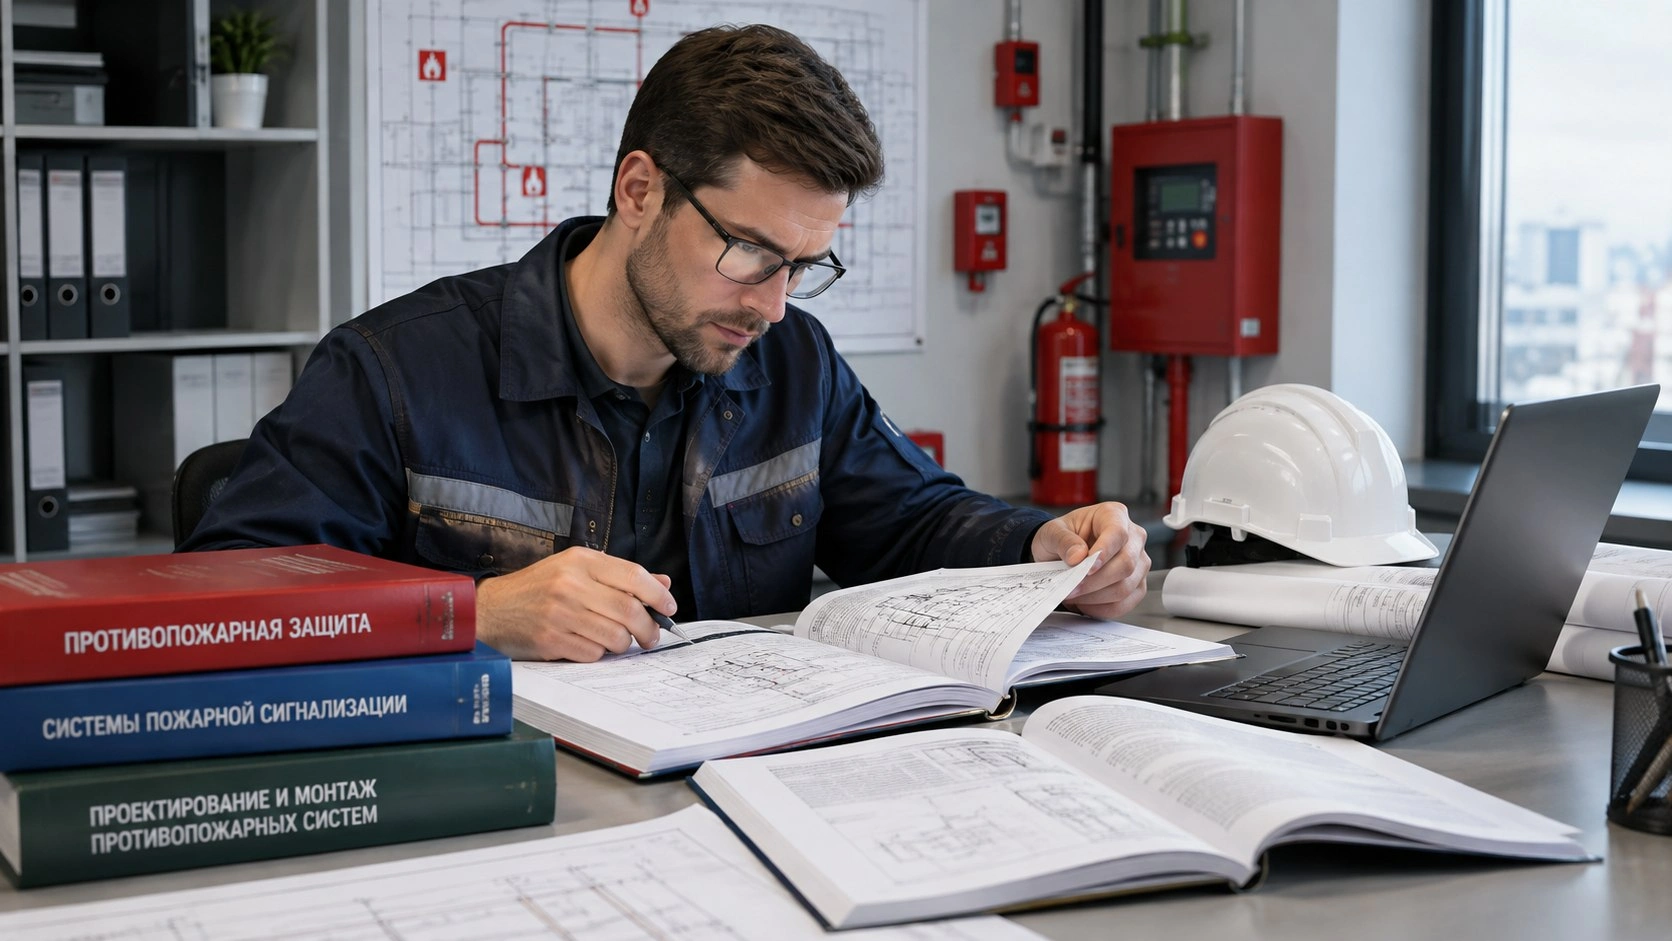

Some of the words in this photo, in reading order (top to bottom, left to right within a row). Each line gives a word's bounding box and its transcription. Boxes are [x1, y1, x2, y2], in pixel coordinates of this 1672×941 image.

[64, 619, 283, 654] ПРОТИВОПОЖАРНАЯ
[289, 613, 372, 639] ЗАЩИТА
[42, 713, 140, 740] СИСТЕМЫ
[146, 701, 255, 732] ПОЖАРНОЙ
[260, 694, 407, 725] СИГНАЛИЗАЦИИ
[89, 789, 271, 828] ПРОЕКТИРОВАНИЕ
[276, 787, 289, 808] И
[295, 779, 378, 806] МОНТАЖ
[91, 813, 298, 854] ПРОТИВОПОЖАРНЫХ
[303, 805, 378, 831] СИСТЕМ
